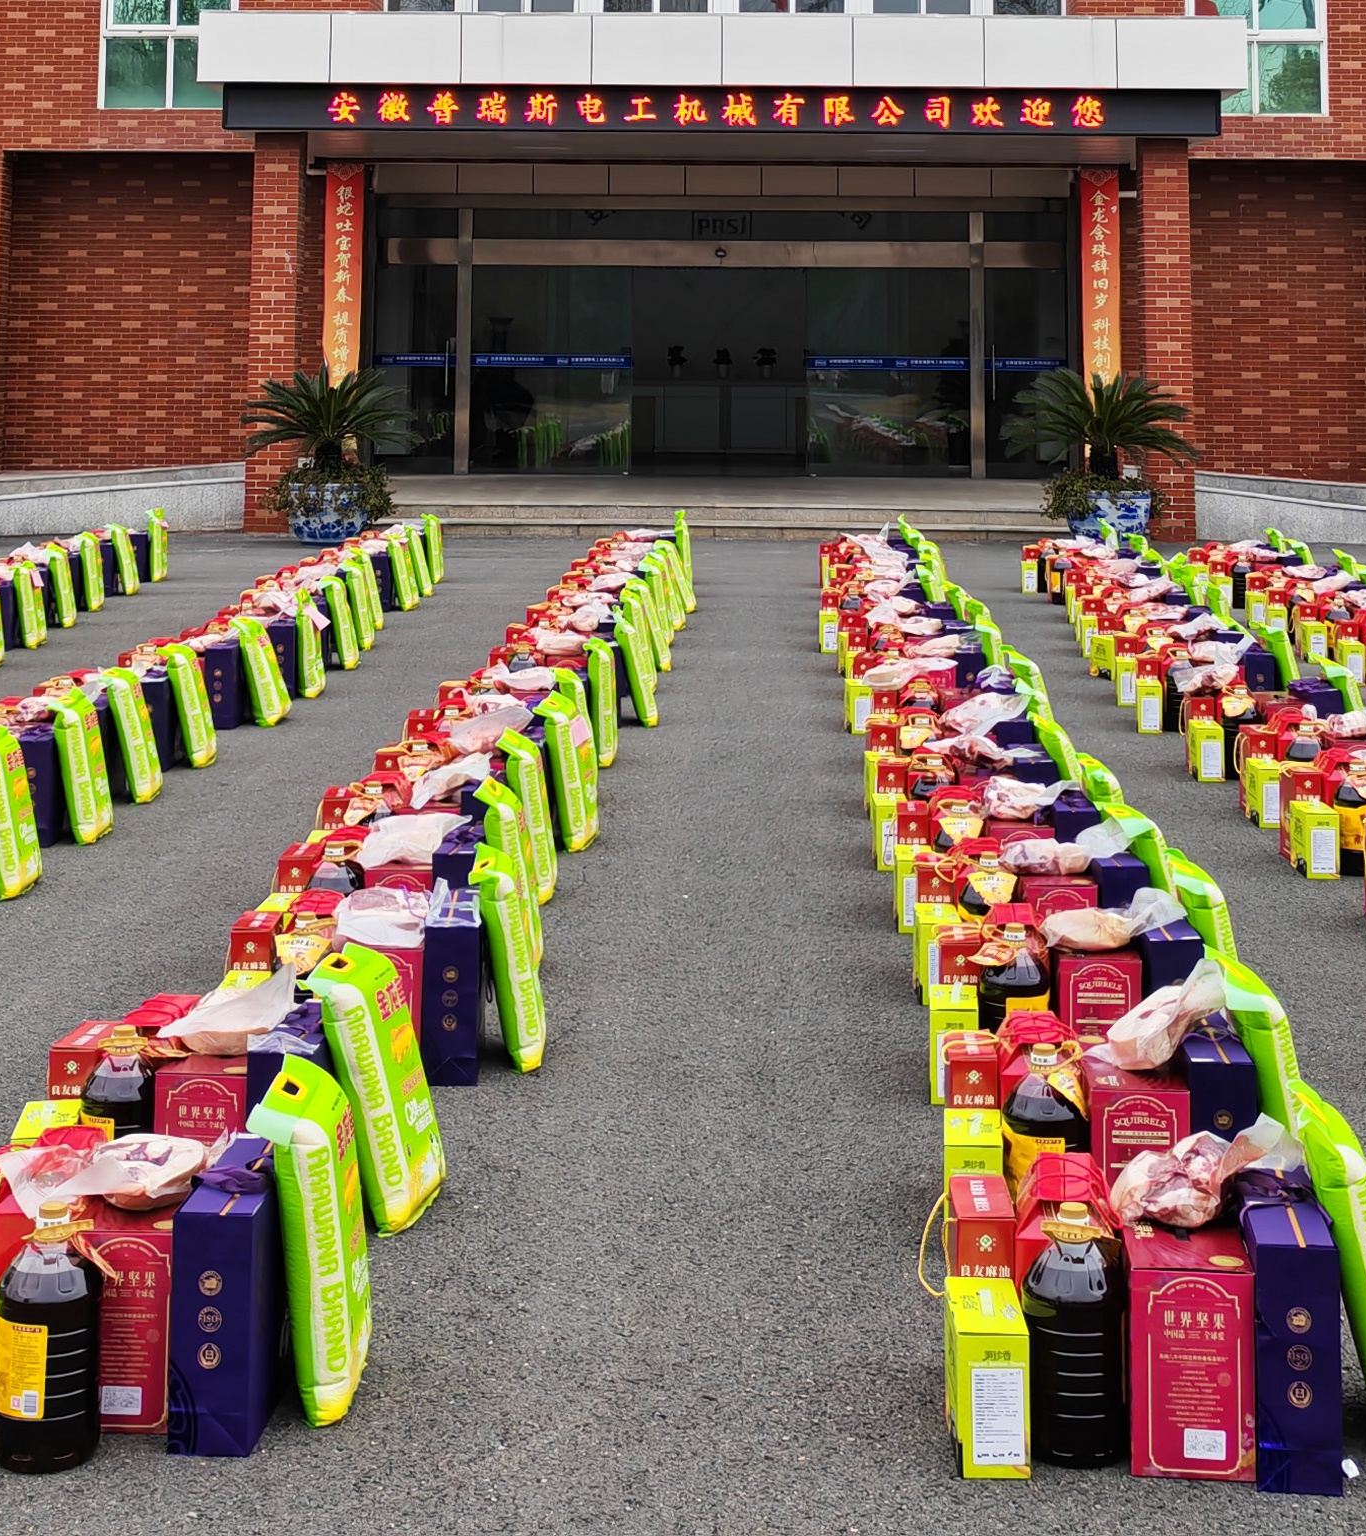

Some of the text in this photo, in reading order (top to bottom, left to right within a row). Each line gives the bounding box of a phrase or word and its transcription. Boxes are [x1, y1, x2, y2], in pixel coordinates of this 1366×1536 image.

[328, 91, 1104, 127] 安徽普瑞斯电工机械有限公司欢迎您
[1089, 189, 1112, 310] 金龙含珠辞旧岁
[1078, 981, 1123, 991] SQUIRRELS
[344, 1004, 405, 1188] ARAWANA BRAND
[178, 1105, 227, 1120] 世界坚果
[1114, 1115, 1168, 1128] SQUIRRELS
[306, 1145, 347, 1373] ARAWANA BRAND
[960, 1264, 1011, 1277] 良友麻油
[1163, 1309, 1226, 1330] 世界坚果
